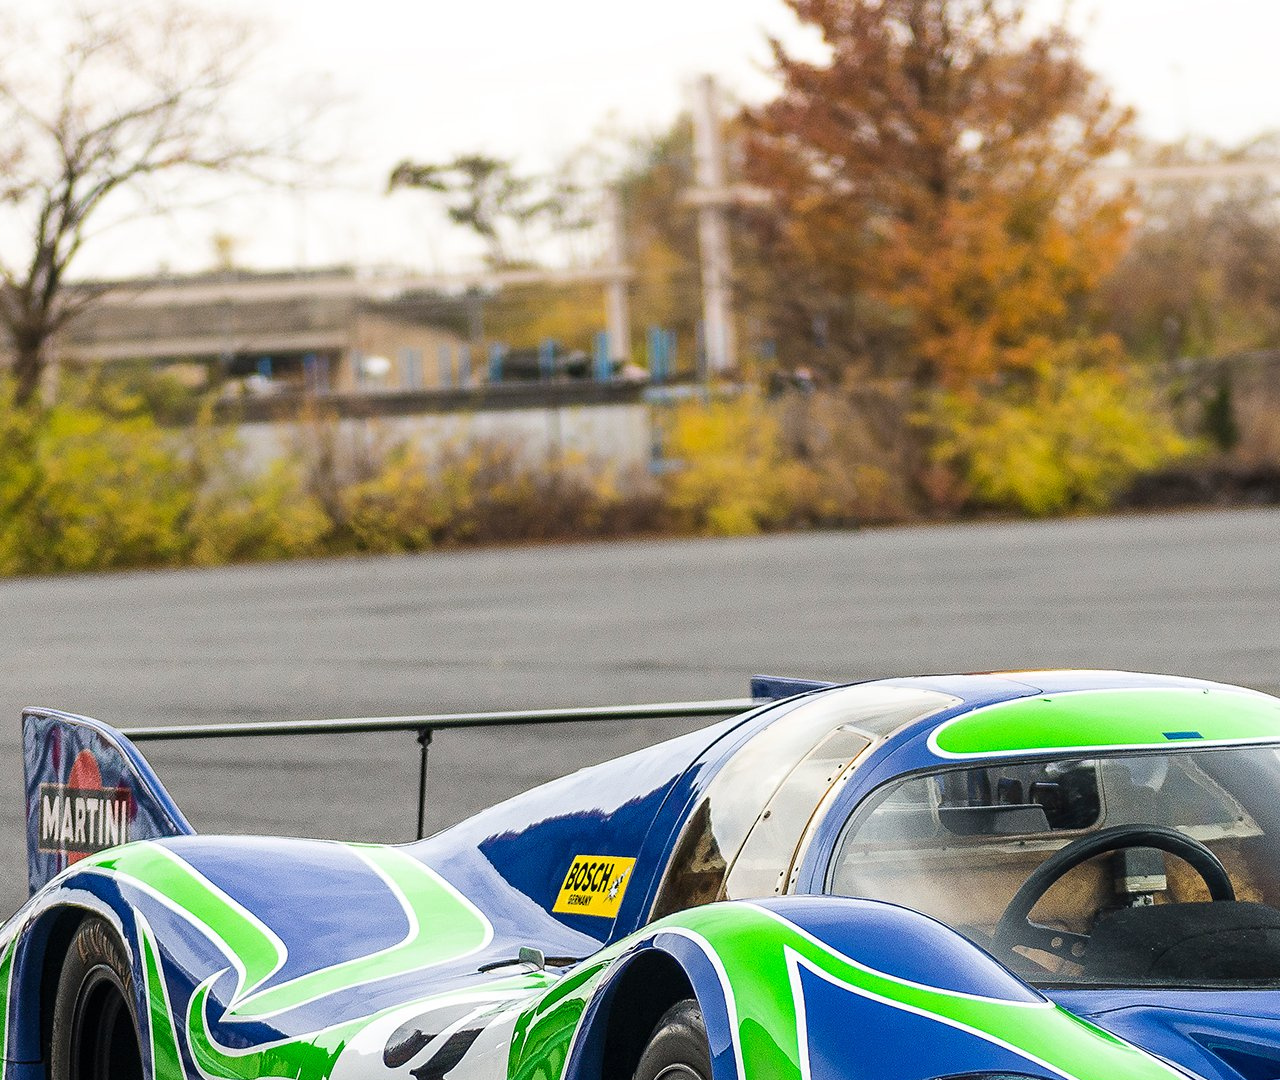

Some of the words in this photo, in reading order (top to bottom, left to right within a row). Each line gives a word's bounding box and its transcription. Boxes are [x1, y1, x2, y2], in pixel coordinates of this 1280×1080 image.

[42, 795, 127, 846] MARTINI
[564, 862, 615, 892] BOSCH
[567, 895, 593, 906] GERMANY
